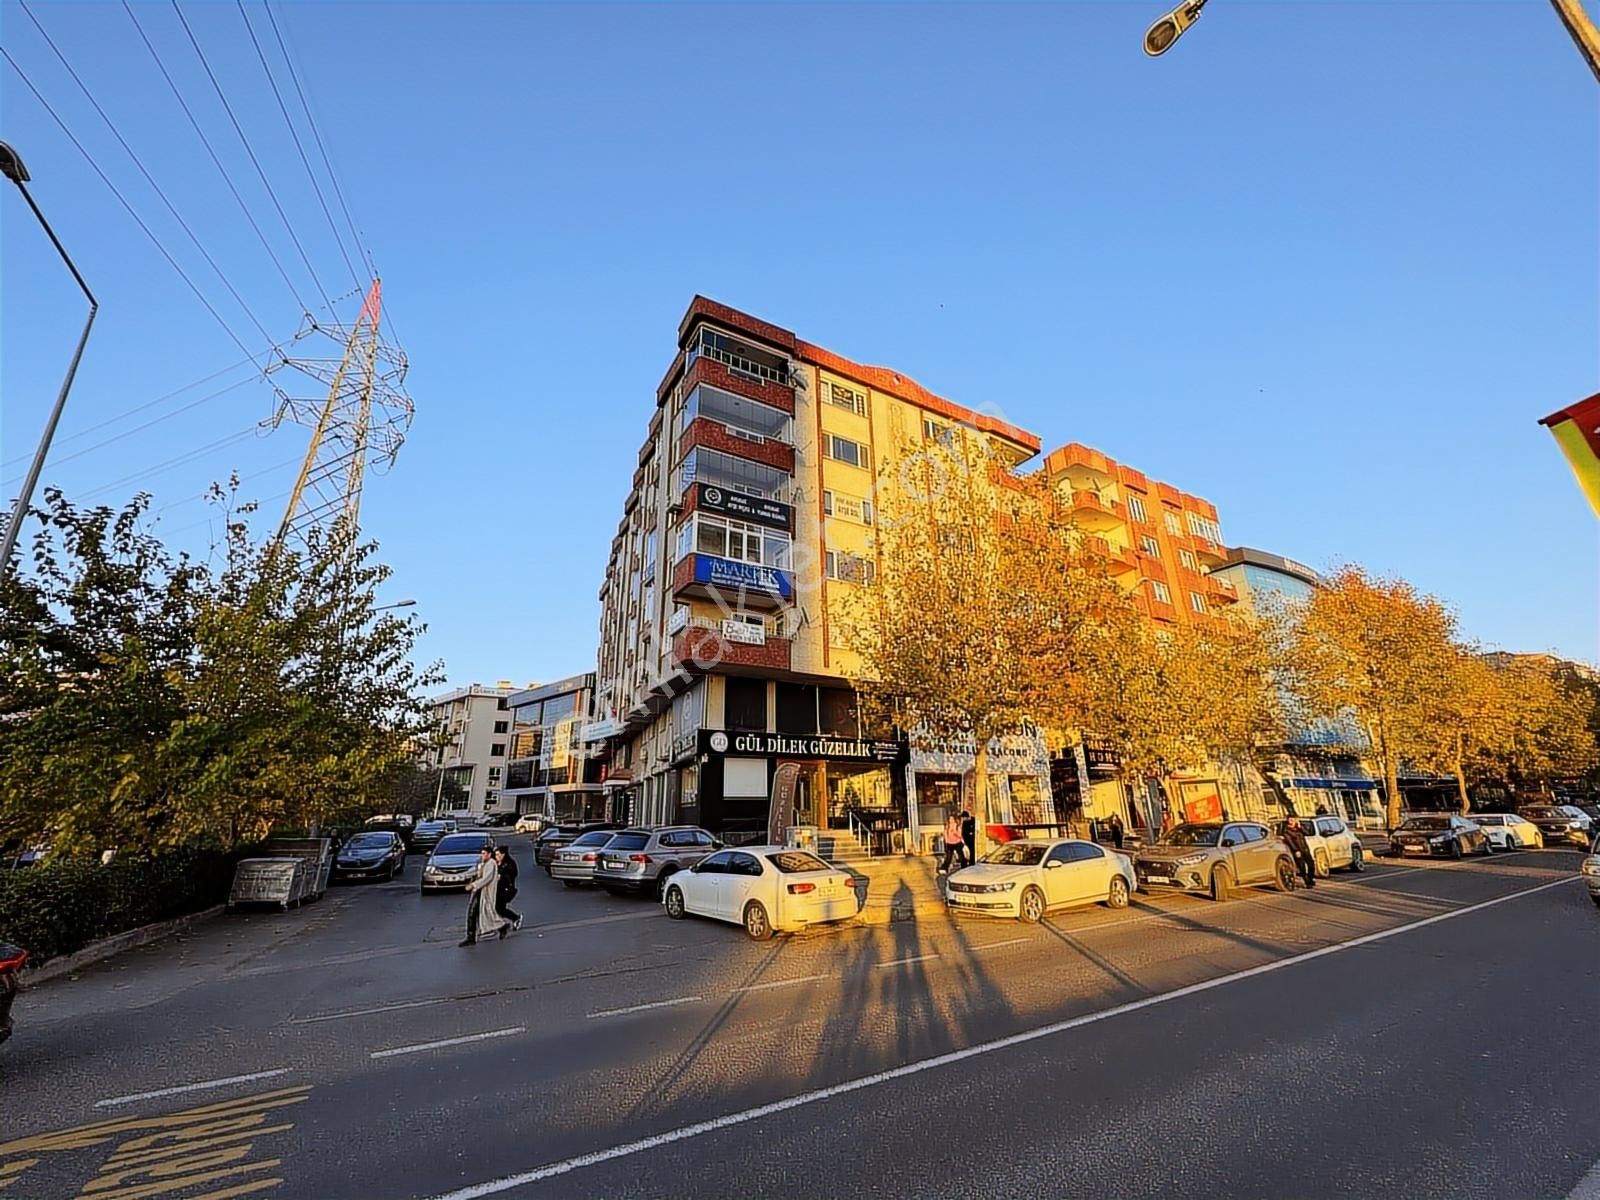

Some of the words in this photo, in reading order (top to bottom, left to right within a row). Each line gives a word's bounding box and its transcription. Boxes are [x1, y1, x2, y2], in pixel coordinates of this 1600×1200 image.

[735, 734, 764, 752] GÜL
[767, 735, 808, 754] DİLEK
[810, 738, 872, 757] GÜZELLİK
